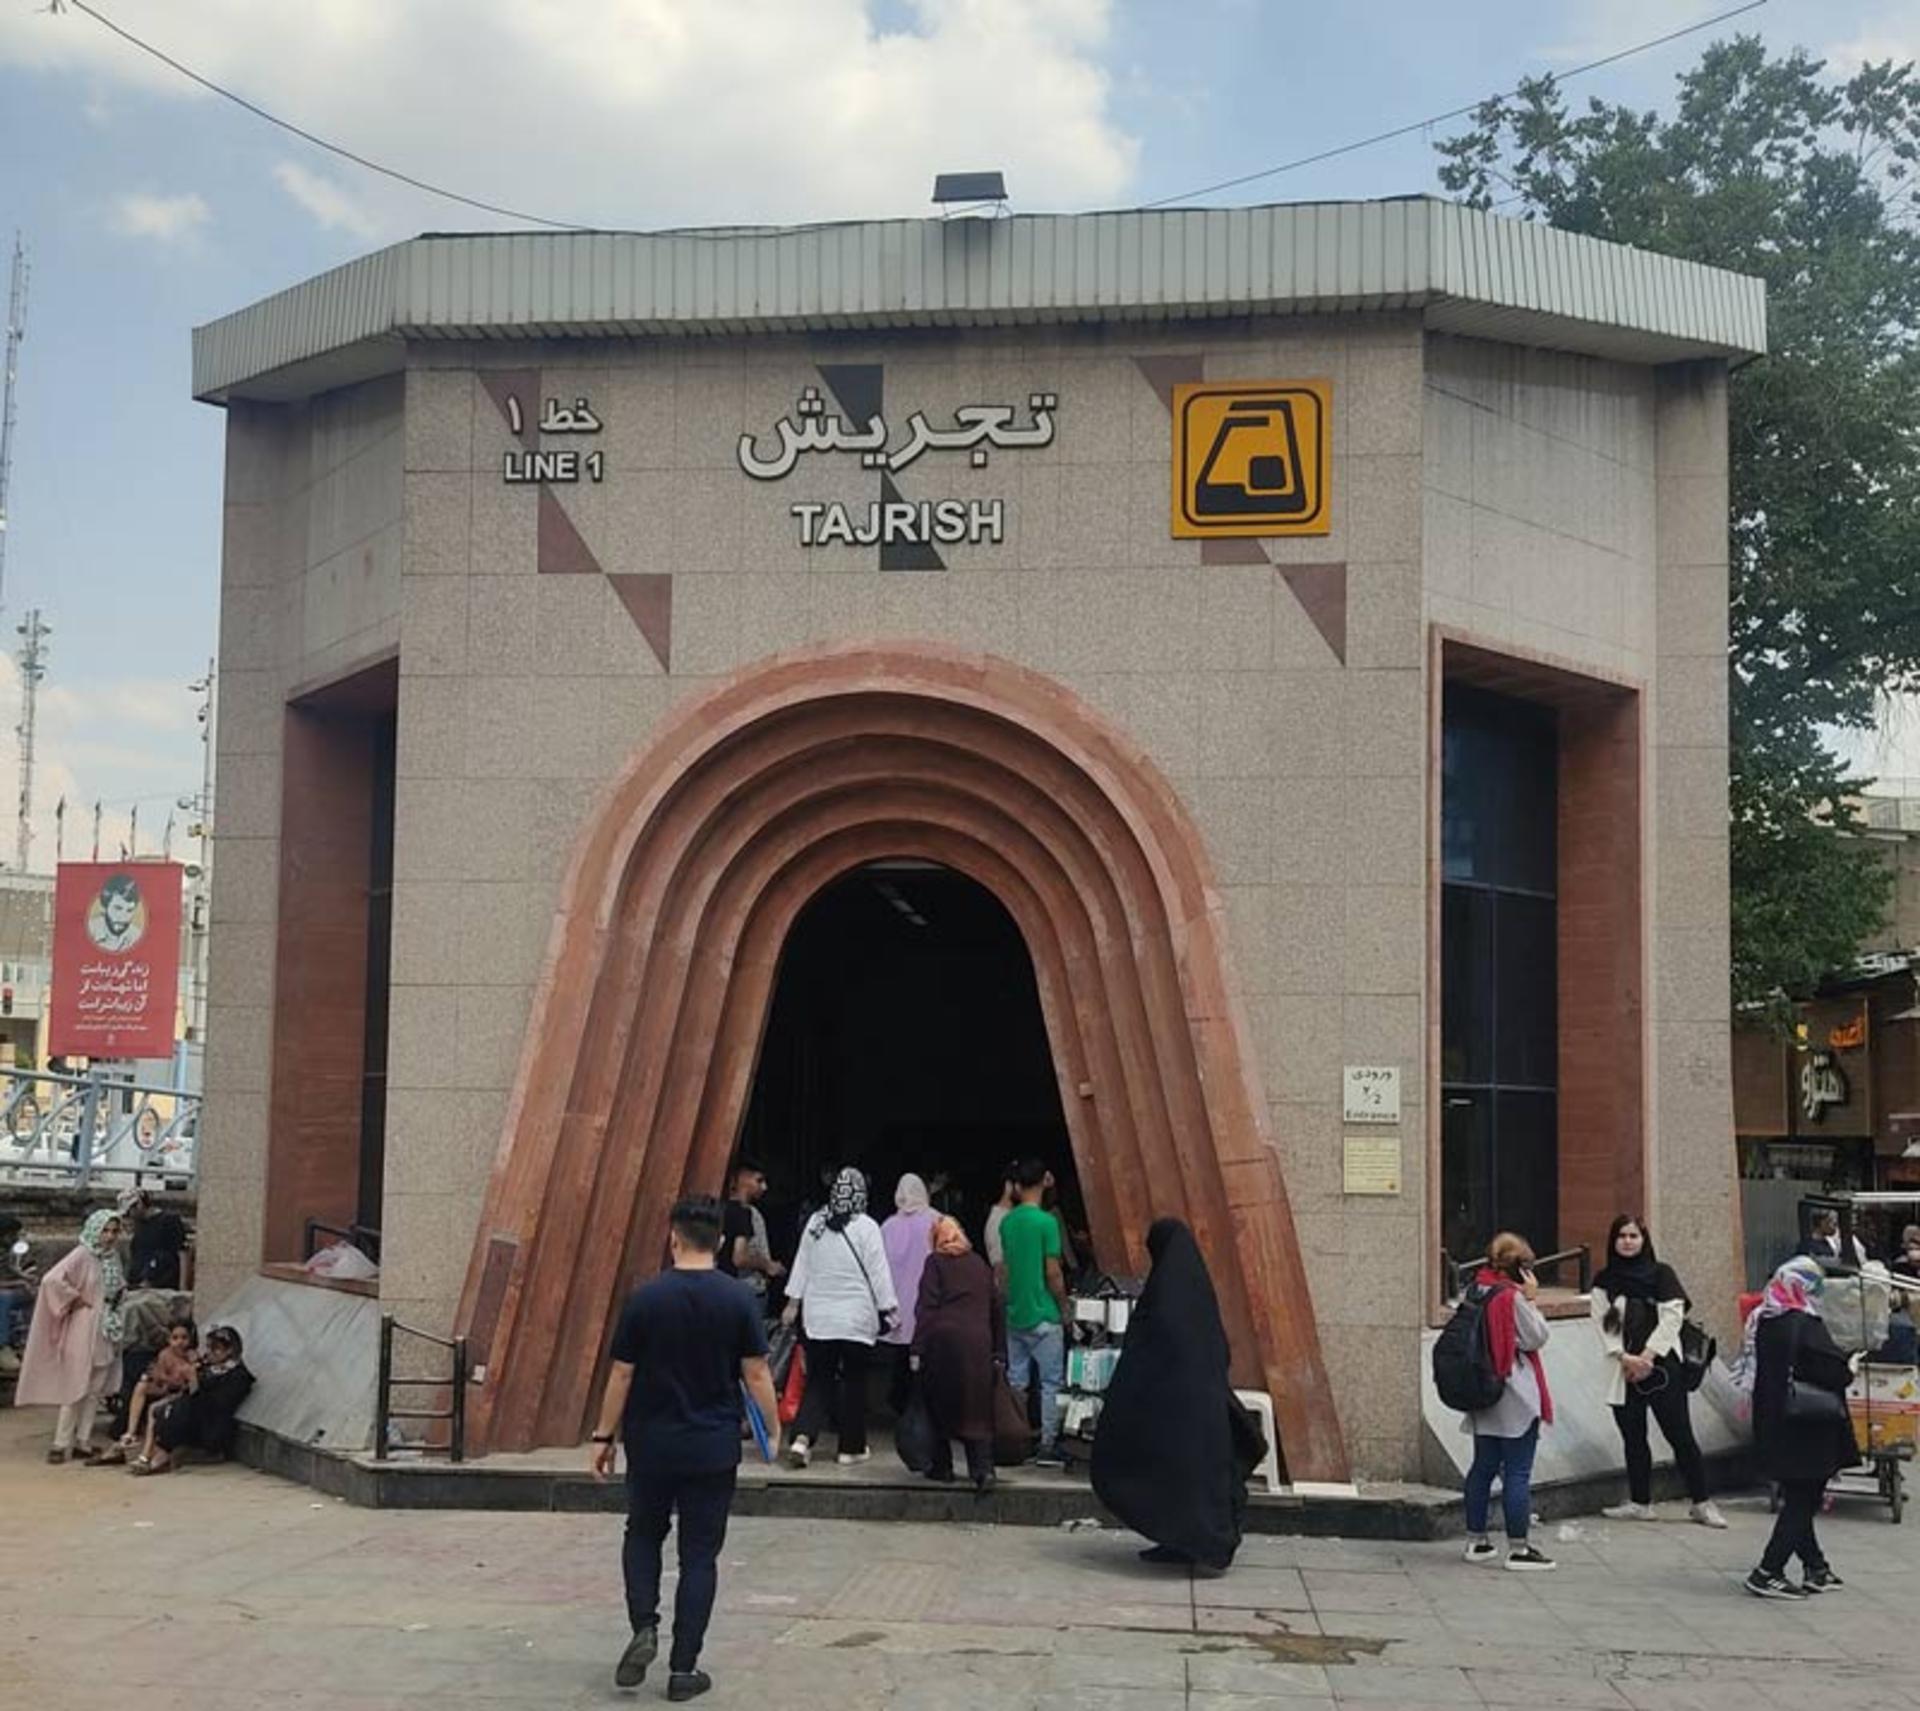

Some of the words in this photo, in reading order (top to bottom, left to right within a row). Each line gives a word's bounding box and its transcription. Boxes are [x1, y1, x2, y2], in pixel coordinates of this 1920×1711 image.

[508, 396, 523, 434] ۱
[539, 399, 602, 433] خط
[738, 386, 1056, 480] تجریش
[505, 452, 577, 482] LINE
[586, 452, 602, 482] 1
[792, 500, 1004, 544] TAJRISH
